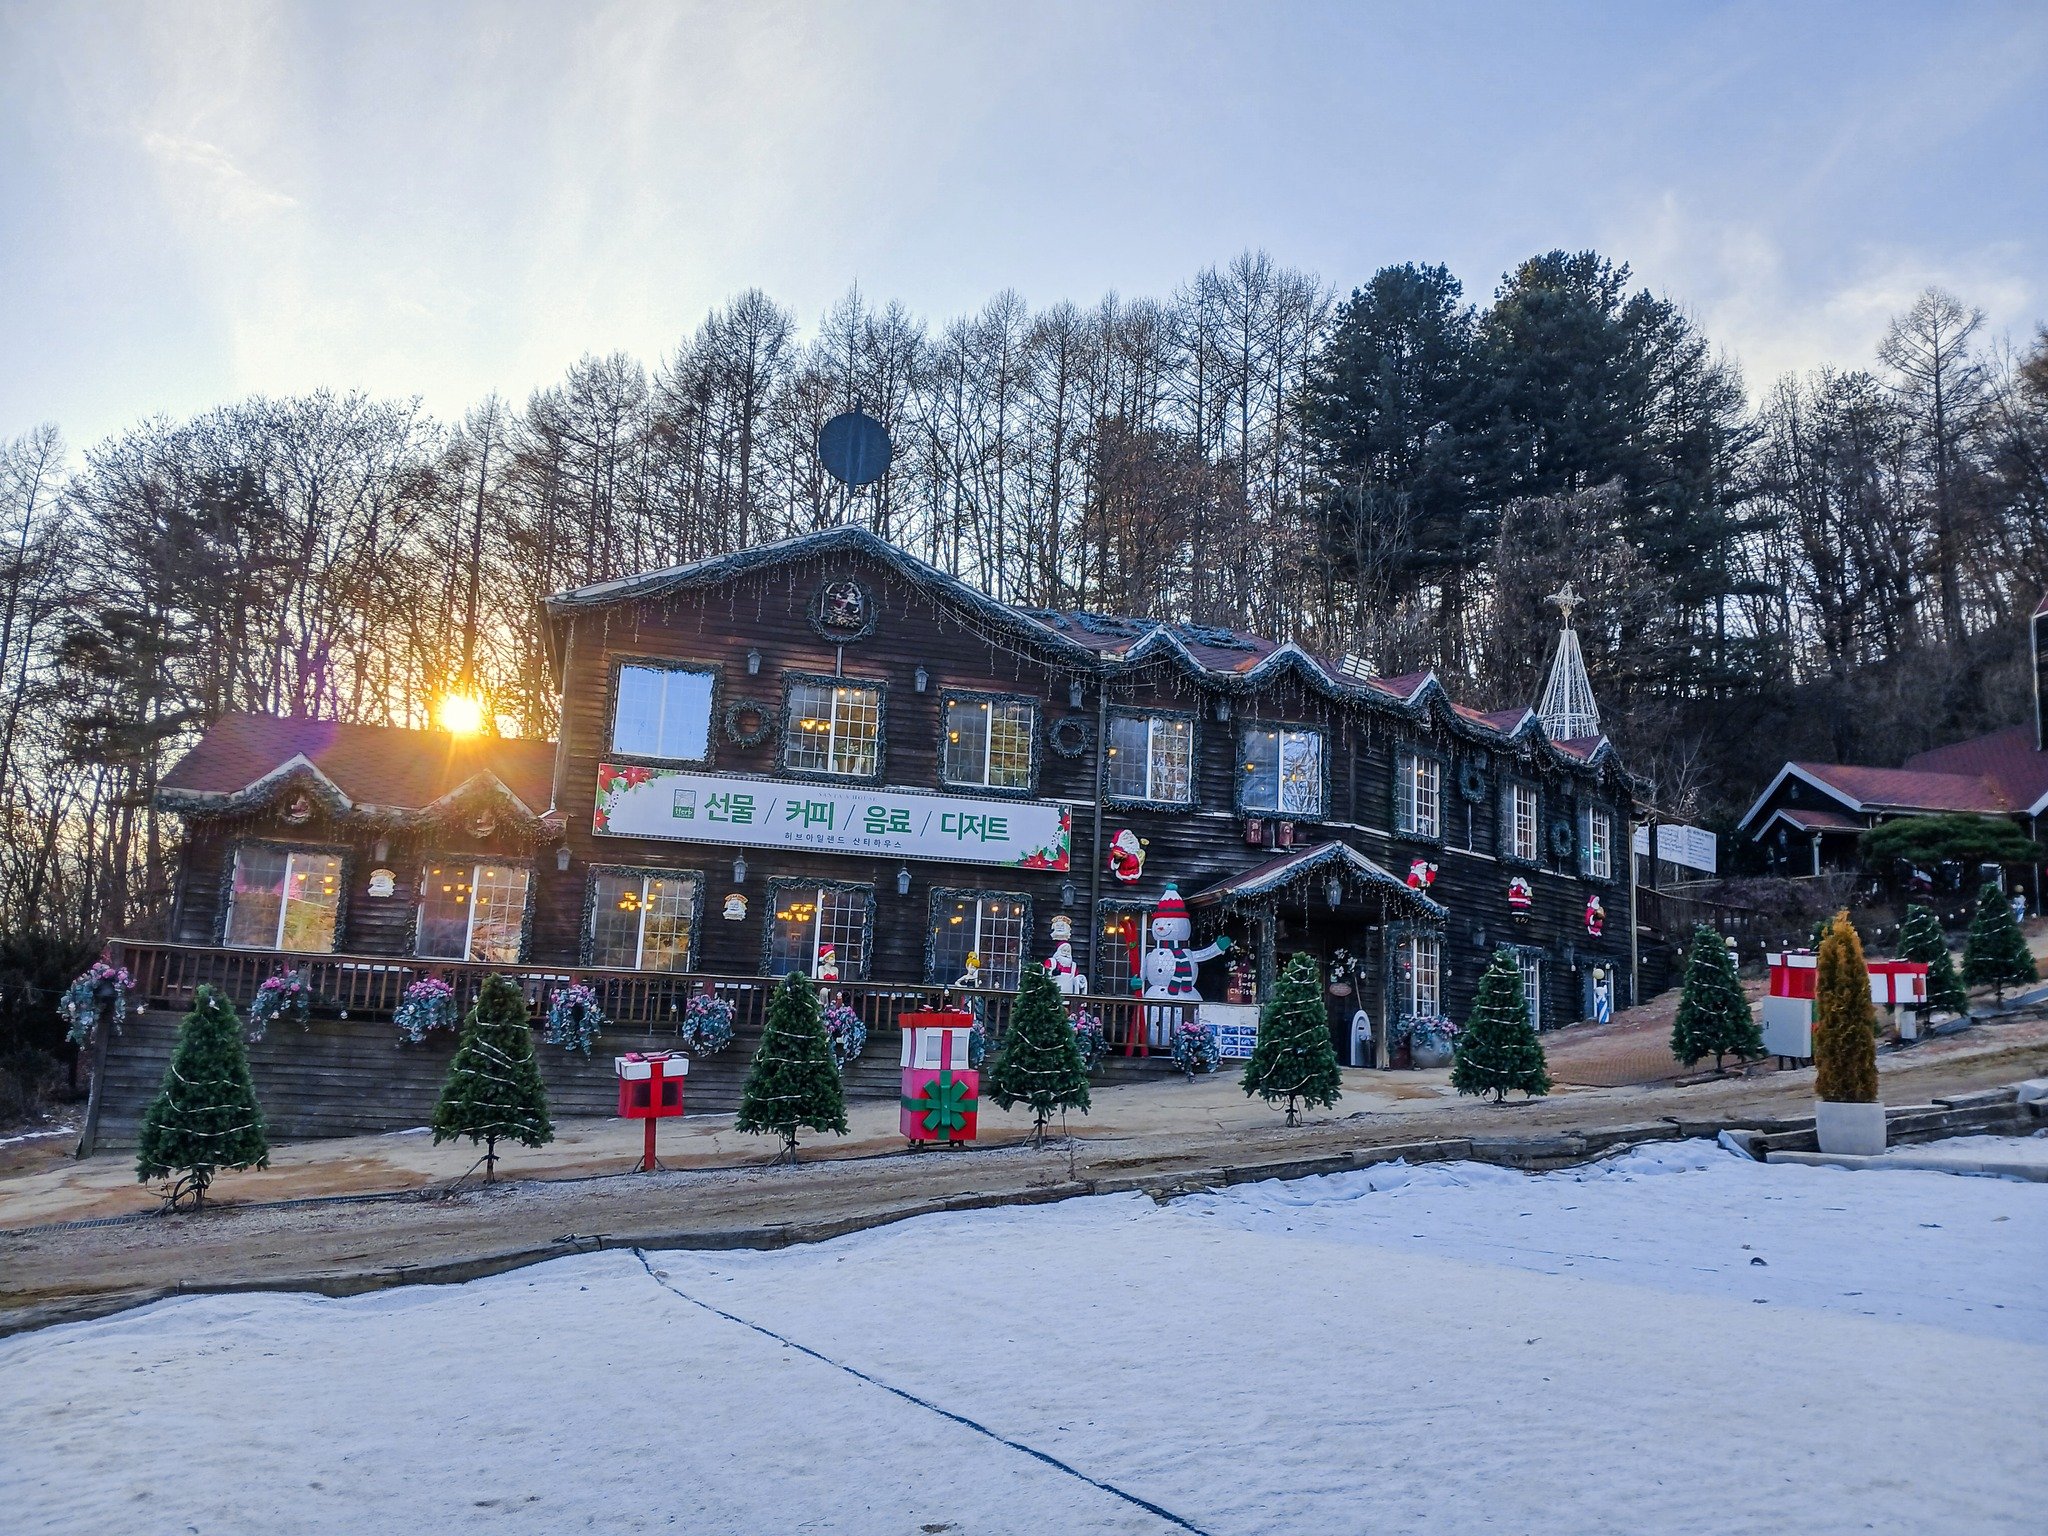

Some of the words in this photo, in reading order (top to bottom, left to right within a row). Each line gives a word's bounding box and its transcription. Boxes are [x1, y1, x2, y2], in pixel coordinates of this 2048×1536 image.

[704, 793, 757, 825] 선물
[785, 799, 835, 831] 커피
[863, 805, 913, 835] 음료
[940, 812, 1011, 843] 디저트
